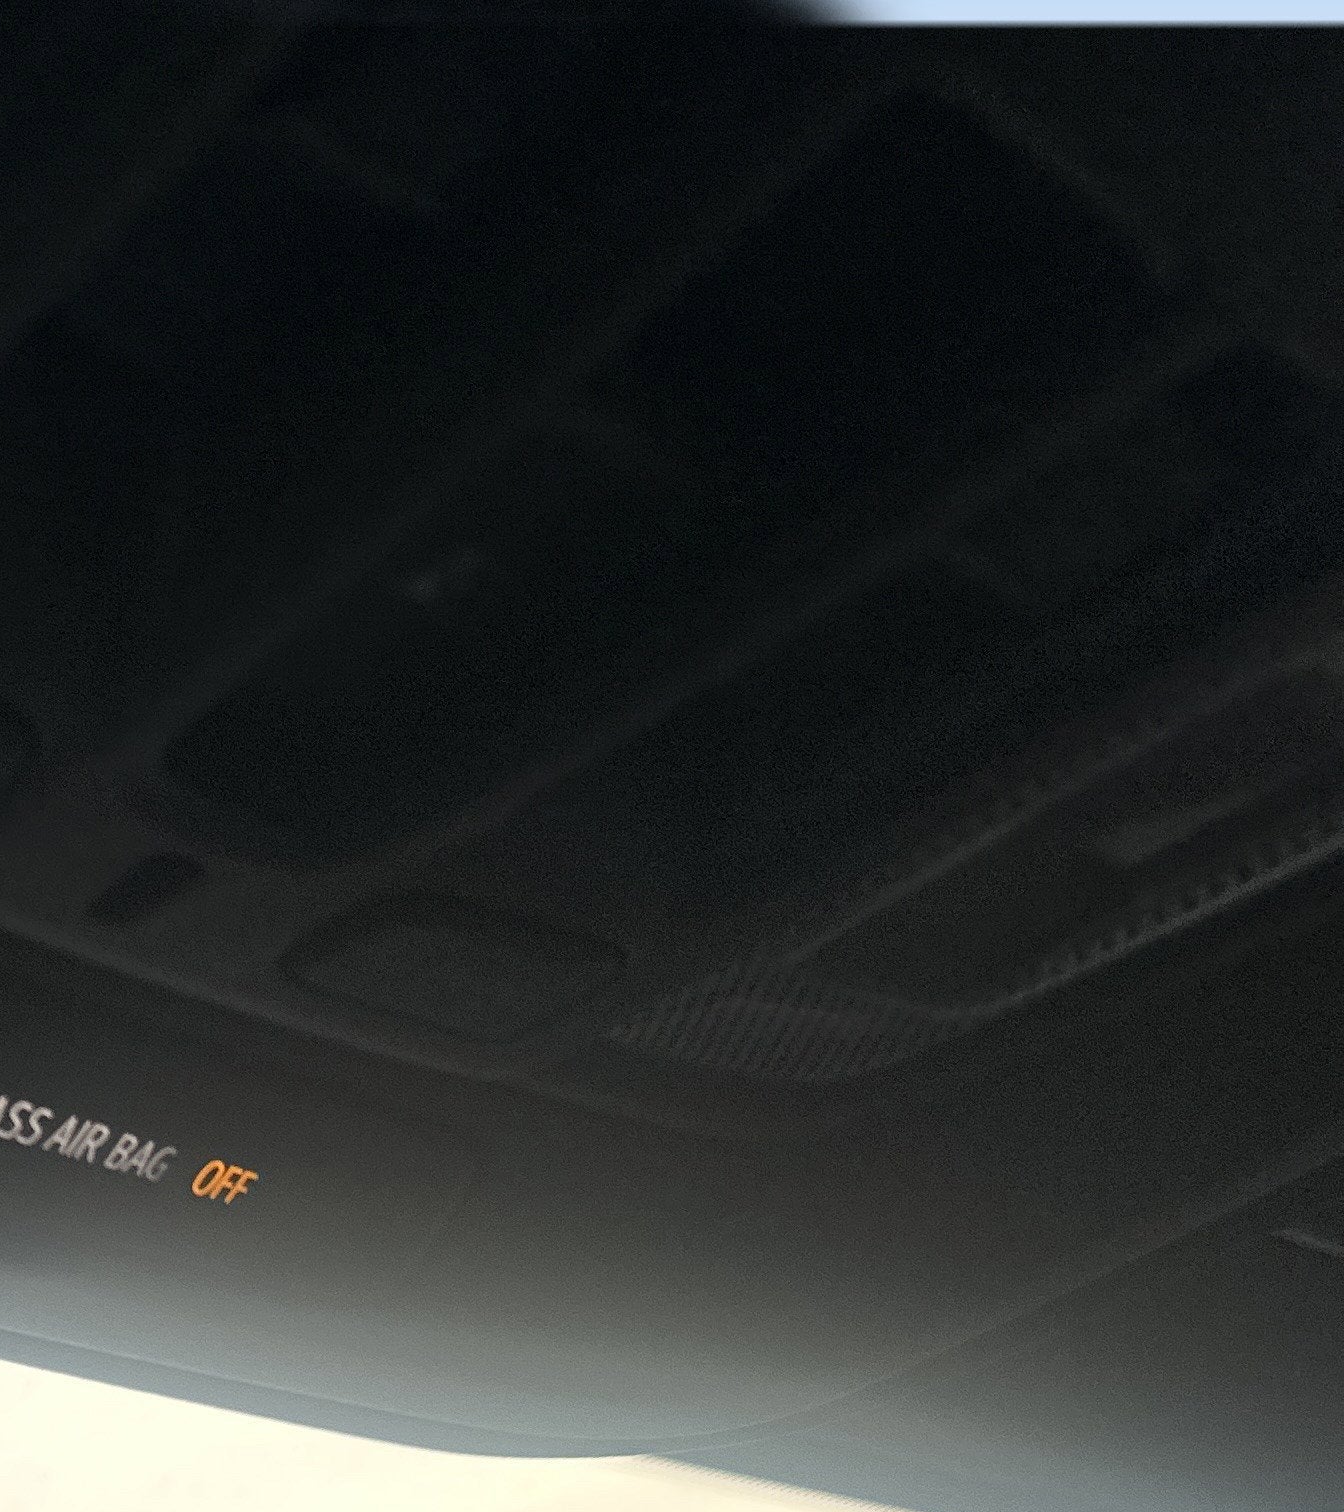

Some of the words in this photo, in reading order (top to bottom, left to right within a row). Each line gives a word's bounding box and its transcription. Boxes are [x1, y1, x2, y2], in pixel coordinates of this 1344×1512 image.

[43, 1115, 110, 1163] AIR
[104, 1132, 177, 1182] BAG
[192, 1160, 260, 1205] OFF
